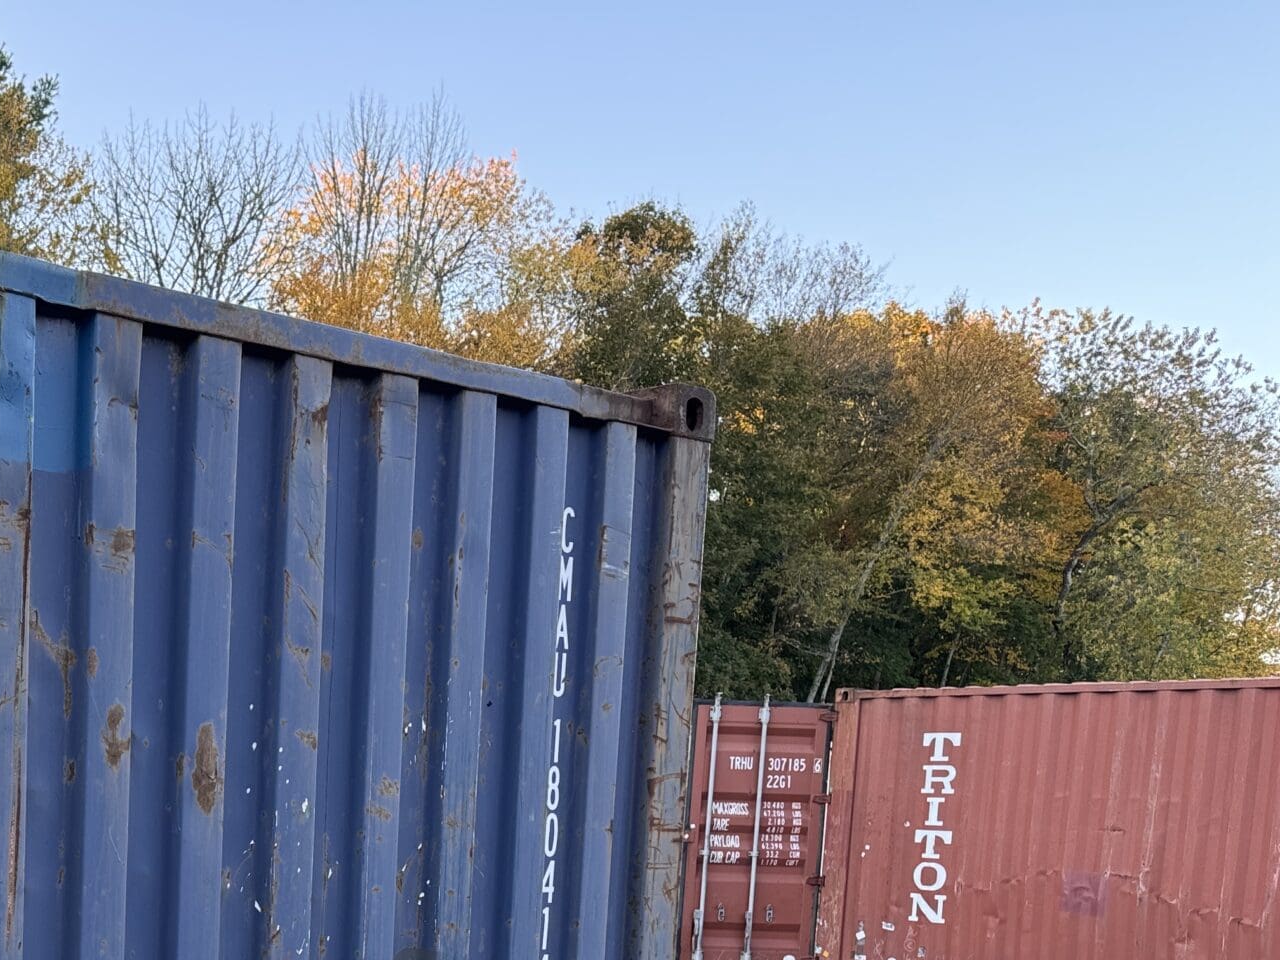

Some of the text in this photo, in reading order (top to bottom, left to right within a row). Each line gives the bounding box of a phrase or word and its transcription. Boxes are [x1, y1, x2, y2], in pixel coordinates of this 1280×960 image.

[553, 506, 576, 698] CMAU
[729, 756, 754, 770] TRHU
[767, 758, 807, 772] 307185
[766, 775, 792, 789] 22G1
[712, 818, 730, 831] TARE
[908, 732, 962, 924] TRITON
[710, 834, 740, 848] PAYLOAD
